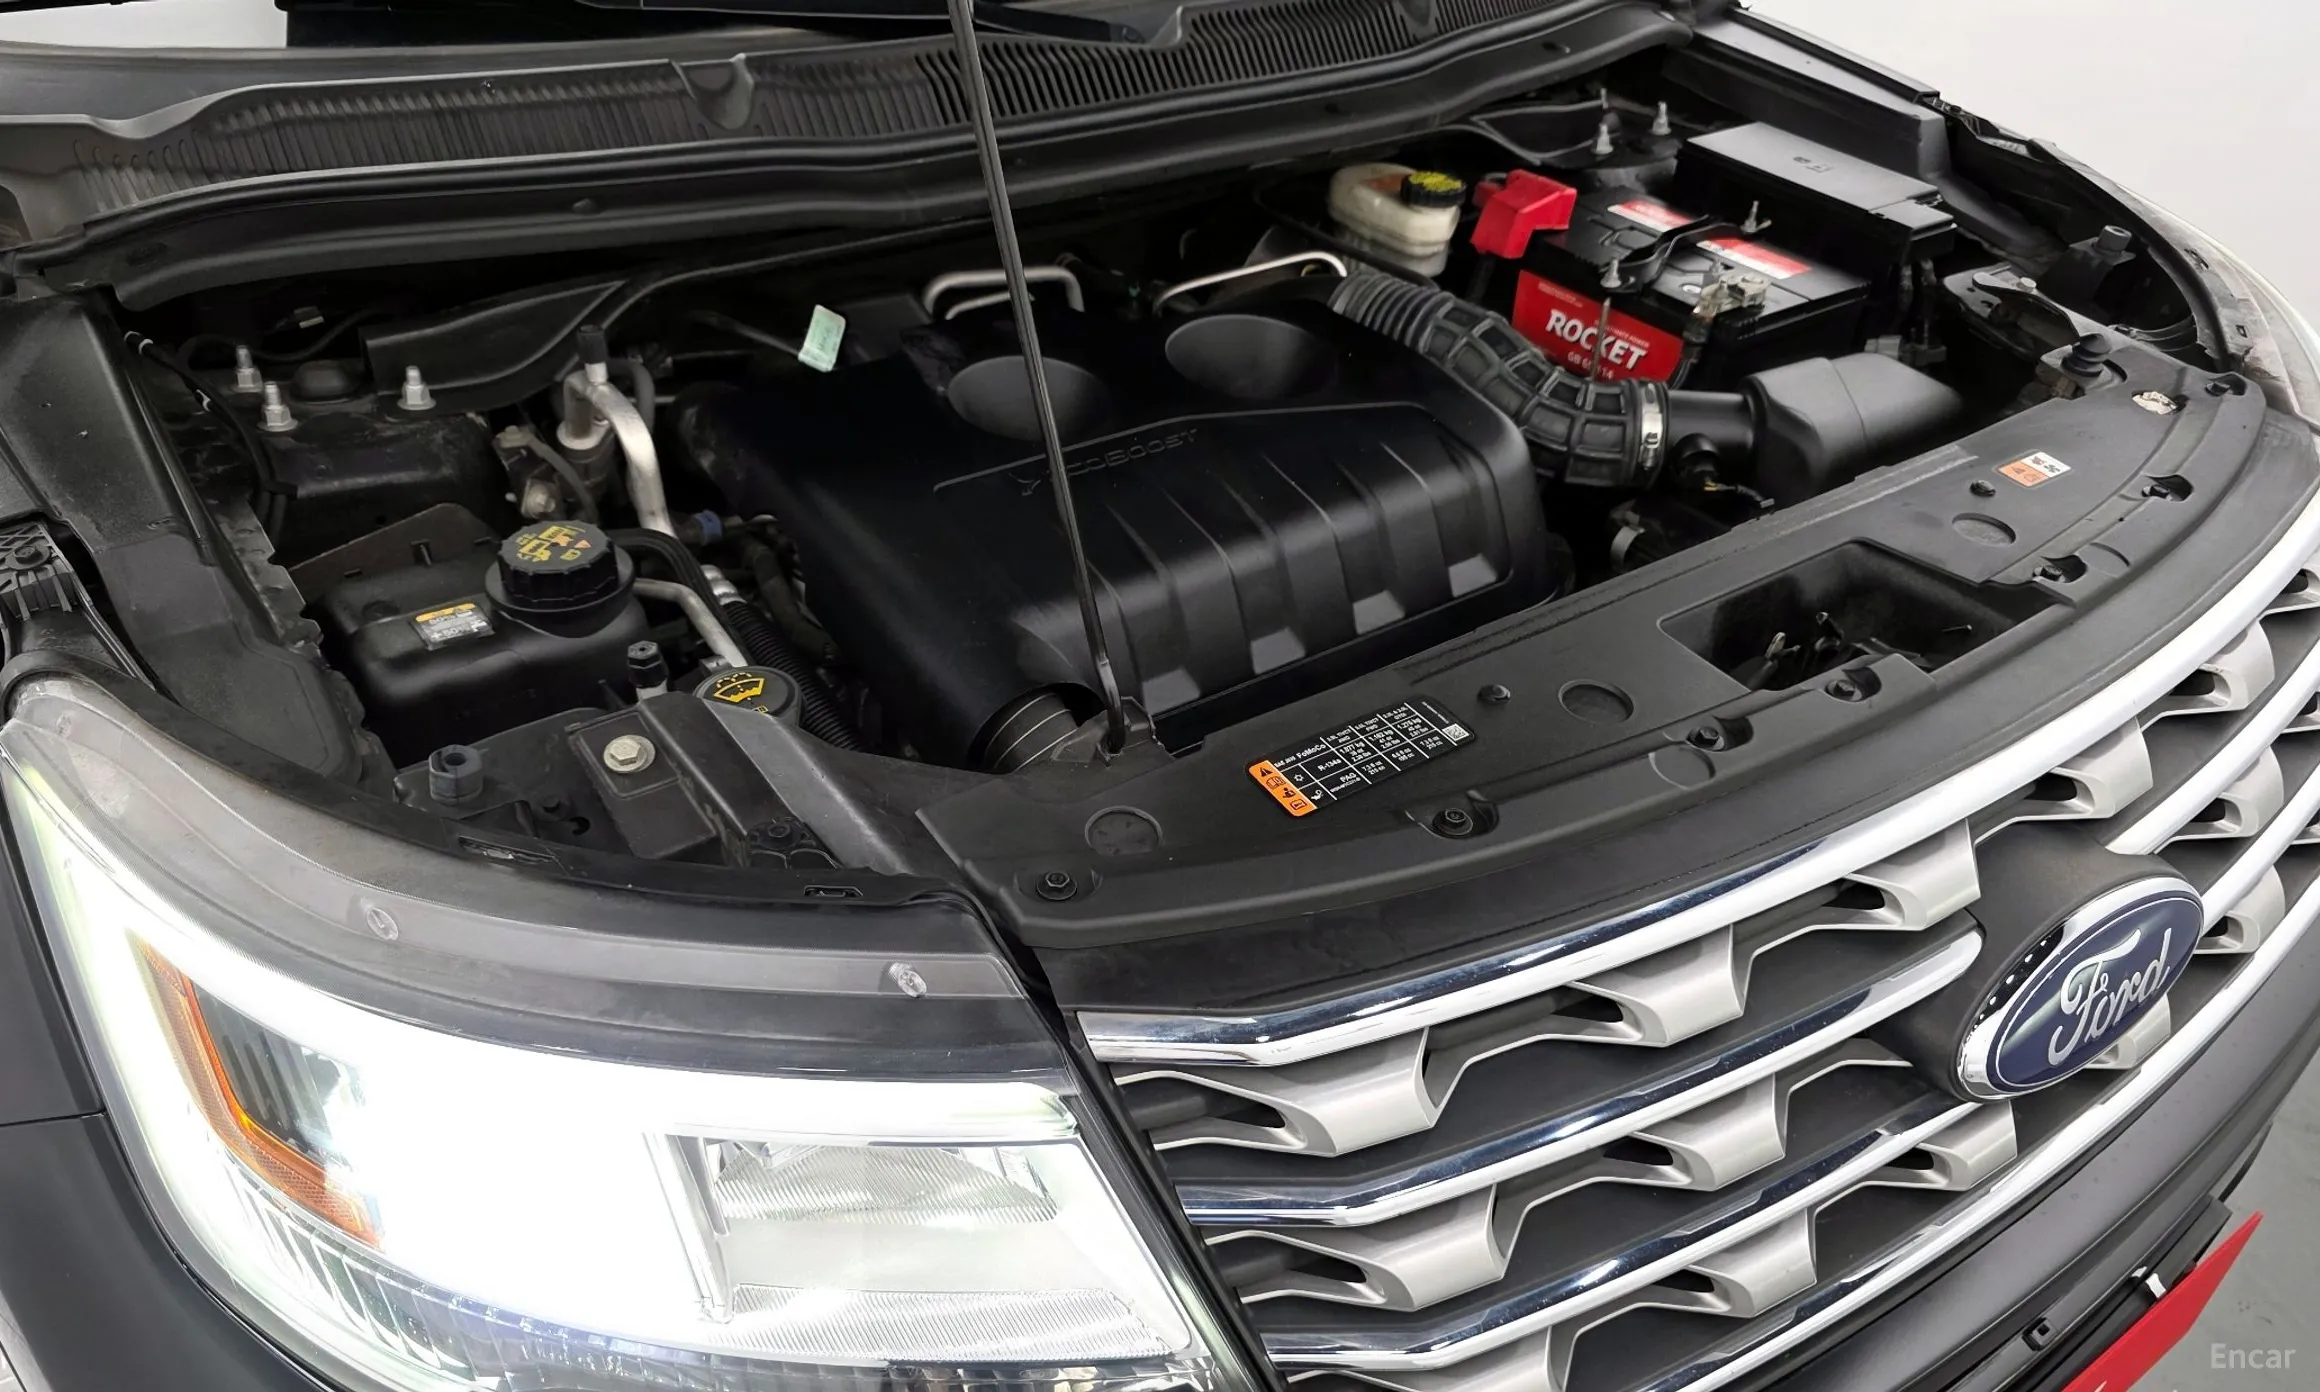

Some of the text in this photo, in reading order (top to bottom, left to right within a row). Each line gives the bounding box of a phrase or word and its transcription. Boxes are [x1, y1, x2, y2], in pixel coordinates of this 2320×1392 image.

[1545, 308, 1649, 370] ROCKET
[1296, 744, 1327, 759] FoMoCo
[1317, 759, 1342, 771] R-134a
[2048, 927, 2172, 1066] Ford
